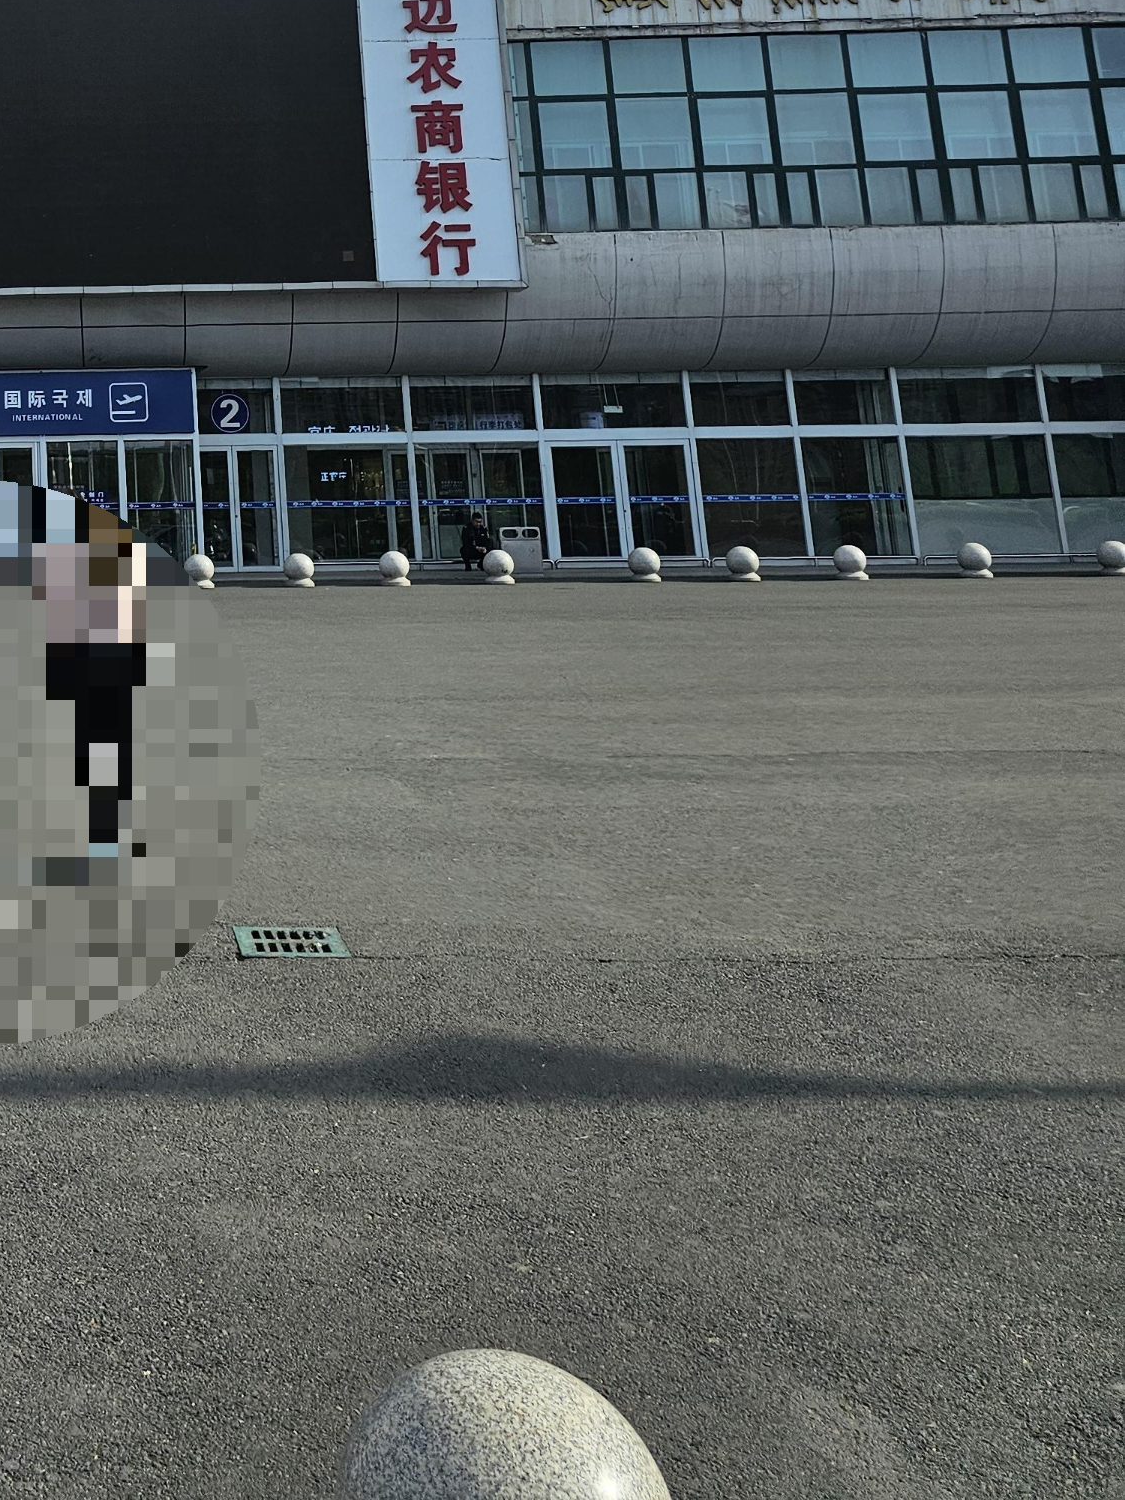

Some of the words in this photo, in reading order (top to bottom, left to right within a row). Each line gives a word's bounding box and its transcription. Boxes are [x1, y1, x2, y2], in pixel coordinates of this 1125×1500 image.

[3, 389, 46, 410] 国际
[51, 387, 93, 409] 국제
[12, 413, 84, 423] INTERNATIONAL
[220, 399, 241, 429] 2
